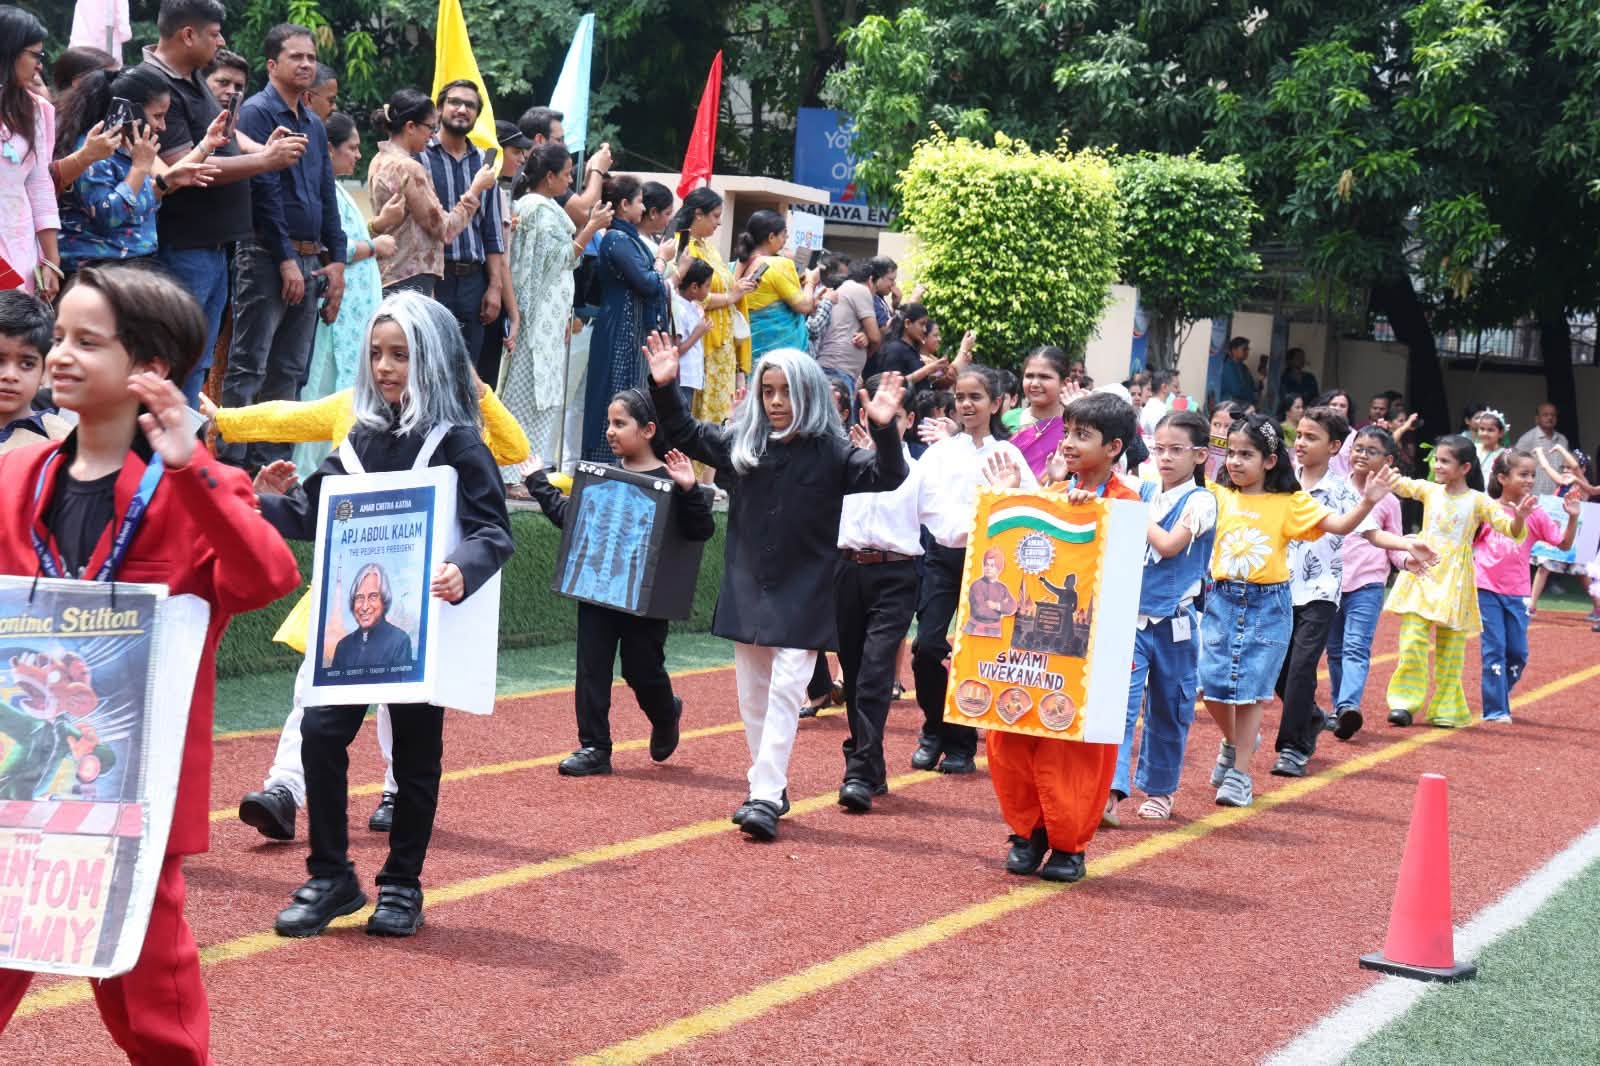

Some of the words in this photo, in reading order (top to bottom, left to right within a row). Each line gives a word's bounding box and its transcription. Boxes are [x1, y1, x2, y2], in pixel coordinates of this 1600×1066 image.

[341, 527, 358, 545] APJ
[360, 524, 390, 543] ABDUL
[391, 522, 422, 540] KALAM
[59, 606, 138, 633] Stilton
[996, 650, 1048, 670] SWAMI
[978, 661, 1064, 690] VIVEKANAND
